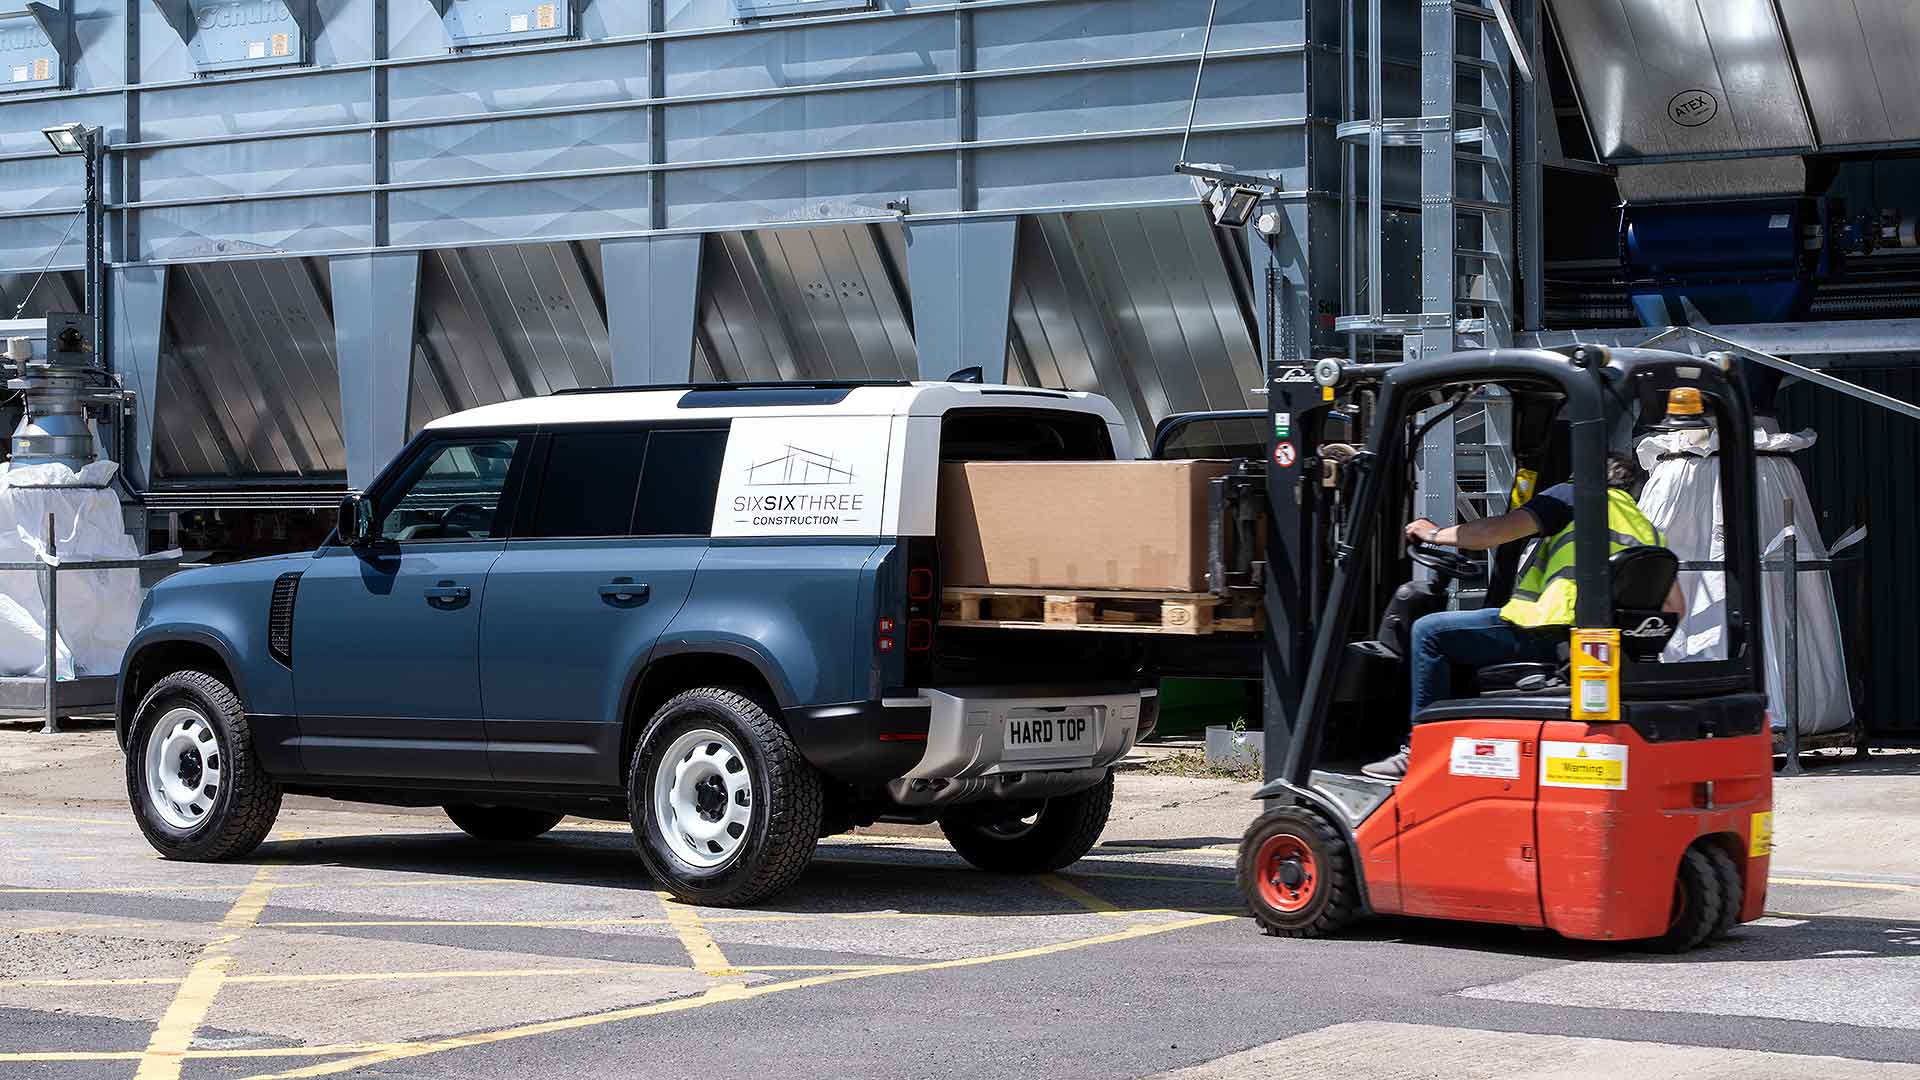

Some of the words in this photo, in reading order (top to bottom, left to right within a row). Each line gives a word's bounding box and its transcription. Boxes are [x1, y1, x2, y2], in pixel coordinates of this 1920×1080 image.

[1675, 96, 1708, 117] ATEX
[1273, 368, 1315, 383] Linde
[733, 494, 865, 512] SIXSIXTHREE
[752, 515, 839, 526] CONSTRUCTION
[1622, 616, 1672, 638] Linde
[1010, 719, 1053, 744] HARD
[1057, 718, 1086, 742] TOP
[1562, 762, 1605, 776] Warning
